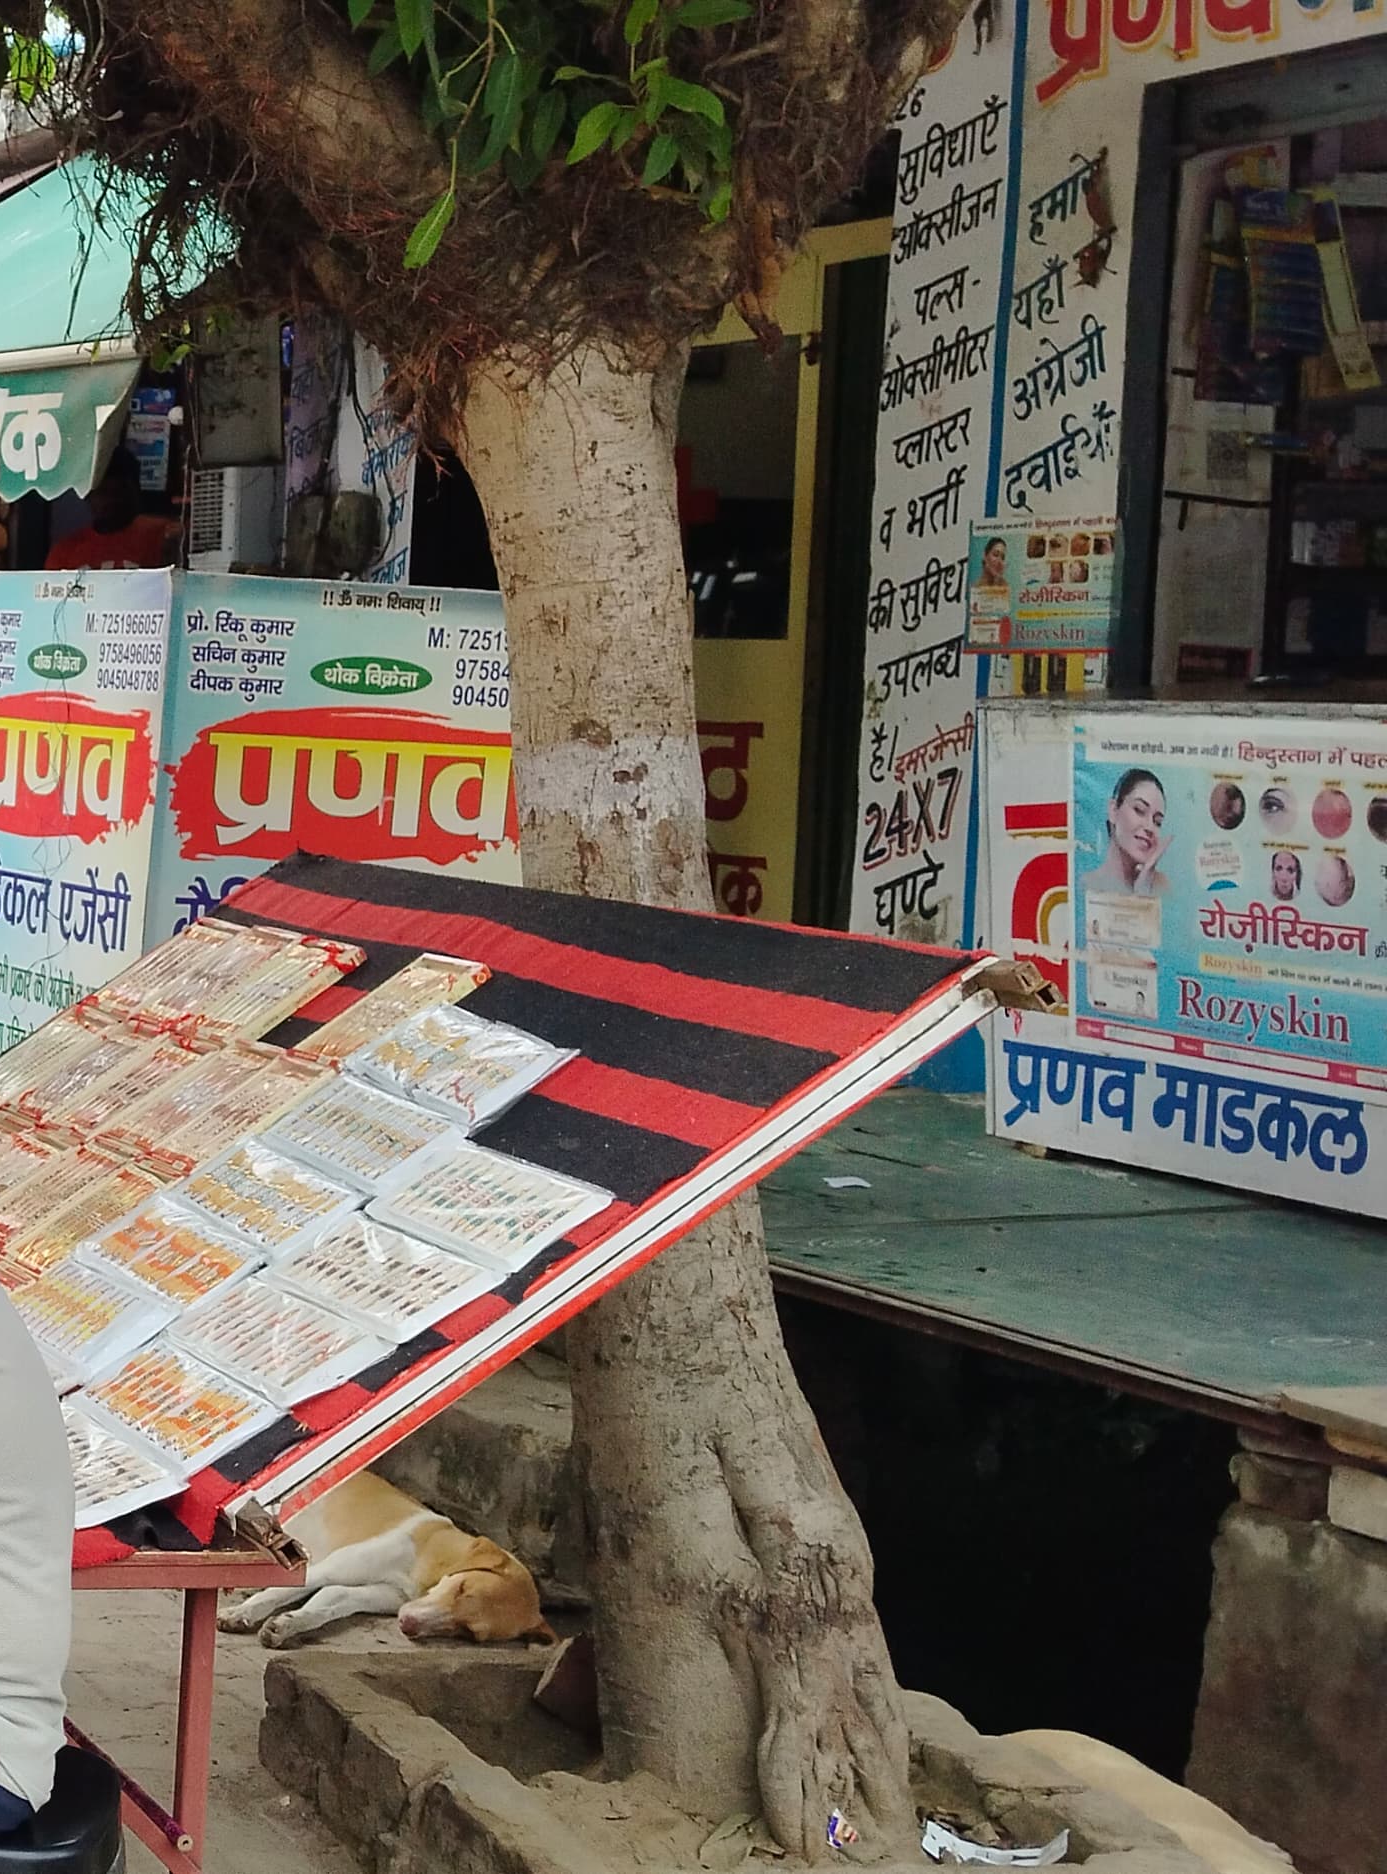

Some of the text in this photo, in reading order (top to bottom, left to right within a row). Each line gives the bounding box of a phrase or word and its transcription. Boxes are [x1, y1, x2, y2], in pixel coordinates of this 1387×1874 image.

[914, 265, 969, 326] पल्स
[1013, 254, 1069, 330] यहाँ
[1012, 313, 1108, 421] अंग्रेजी
[892, 406, 972, 470] प्लास्टर
[880, 464, 969, 552] व भर्ती
[102, 613, 165, 635] 7251966057
[338, 590, 353, 607] ॐ
[355, 594, 383, 610] नमः
[868, 557, 969, 634] की सुविध
[99, 642, 163, 665] 9758496056
[187, 610, 296, 643] प्रो. रिंकू कुमार
[192, 640, 286, 674] सचिन कुमार
[428, 627, 508, 652] M: 7251
[97, 668, 159, 691] 9045048788
[189, 668, 284, 702] दीपक कुमार
[324, 665, 419, 689] थोक विक्रेता
[877, 634, 965, 703] उपलब्ध
[1238, 740, 1321, 769] हिन्दुस्तान
[1327, 746, 1347, 765] में
[209, 730, 513, 846] प्रणव
[58, 866, 132, 953] एजेंसी
[873, 849, 946, 935] घण्टे
[1198, 898, 1370, 957] रोज़ीस्किन
[1177, 977, 1350, 1042] Rozyskin
[1003, 1039, 1147, 1132] प्रणव
